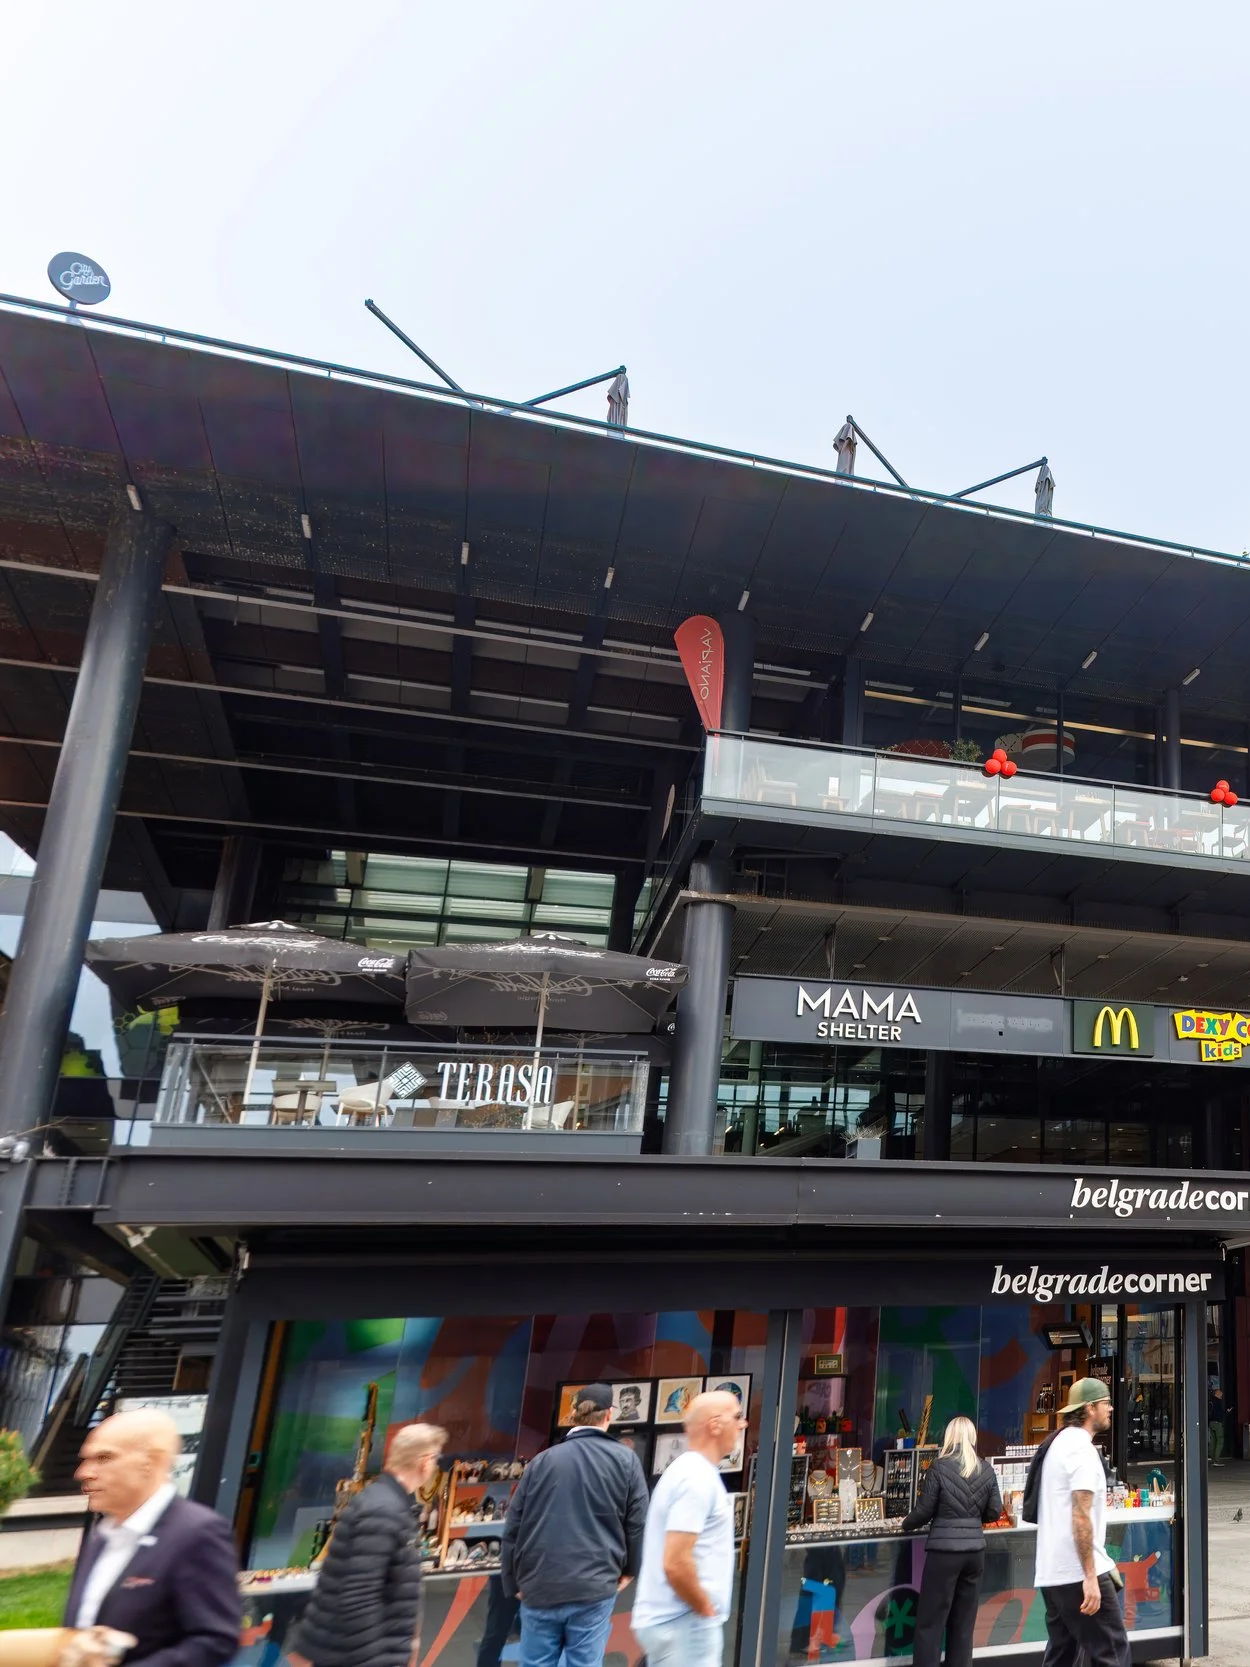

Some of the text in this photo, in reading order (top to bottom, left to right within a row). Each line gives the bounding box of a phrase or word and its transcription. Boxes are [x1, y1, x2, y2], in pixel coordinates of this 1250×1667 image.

[60, 270, 109, 290] Garden
[796, 985, 923, 1024] MAMA
[817, 1022, 901, 1041] SHELTER
[1181, 1015, 1231, 1036] DEXY
[1205, 1043, 1240, 1058] kids
[437, 1062, 553, 1104] TERASA
[992, 1265, 1211, 1302] belgradecorner
